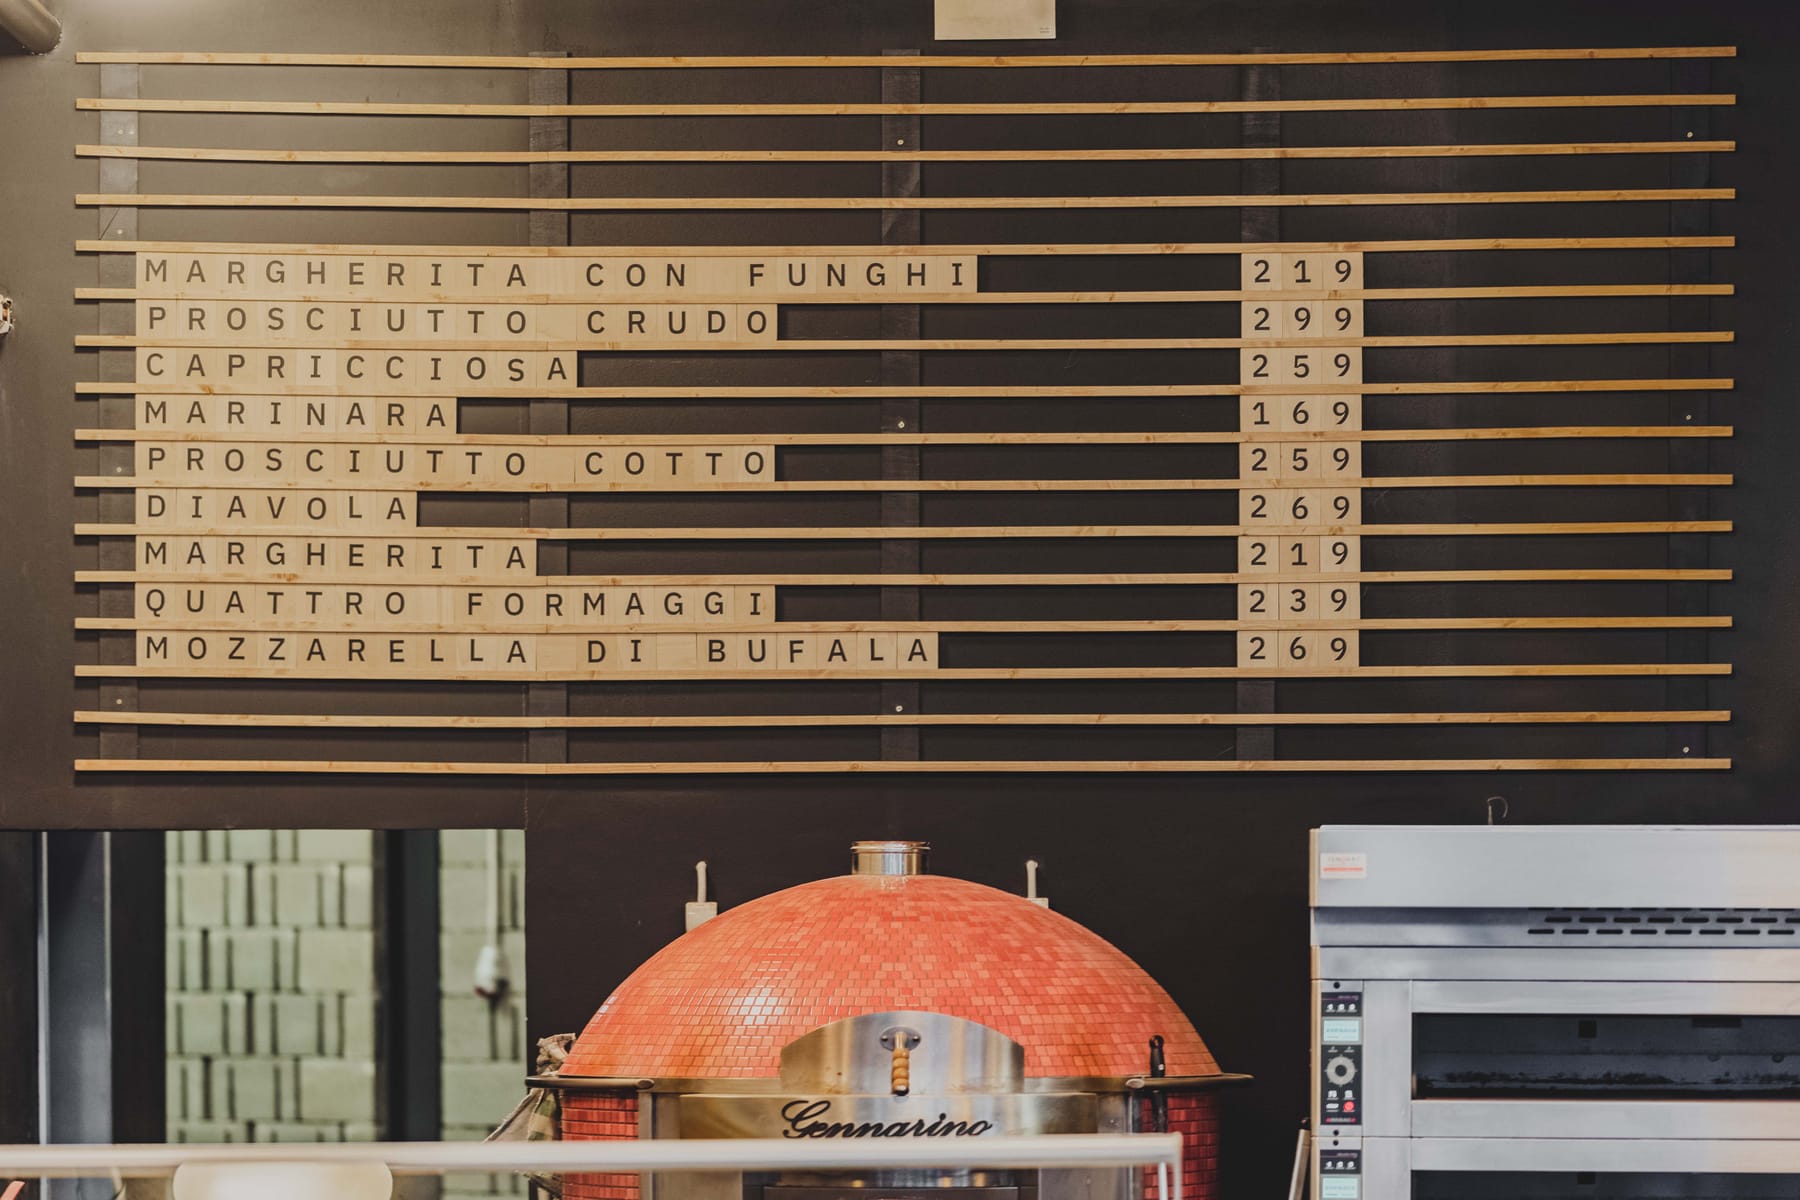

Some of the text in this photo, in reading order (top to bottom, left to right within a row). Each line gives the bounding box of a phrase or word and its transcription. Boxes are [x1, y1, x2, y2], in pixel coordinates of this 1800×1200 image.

[145, 259, 1352, 288] MARGHERITA CON FUNGHI 219
[149, 306, 1352, 335] PROSCIUTTO CRUDO 299
[146, 353, 1351, 382] CAPRICCIOSA 259
[145, 400, 1350, 427] MARINARA 169
[148, 447, 1350, 477] PROSCIUTTO COTTO 259
[147, 494, 1350, 521] DIAVOLA 269
[145, 541, 1349, 570] MARGHERITA 219
[145, 588, 1347, 618] QUATTRO FORMAGGI 239
[146, 636, 1348, 664] MOZZARELLA DI BUFALA 269
[781, 1100, 993, 1139] Gennarino
